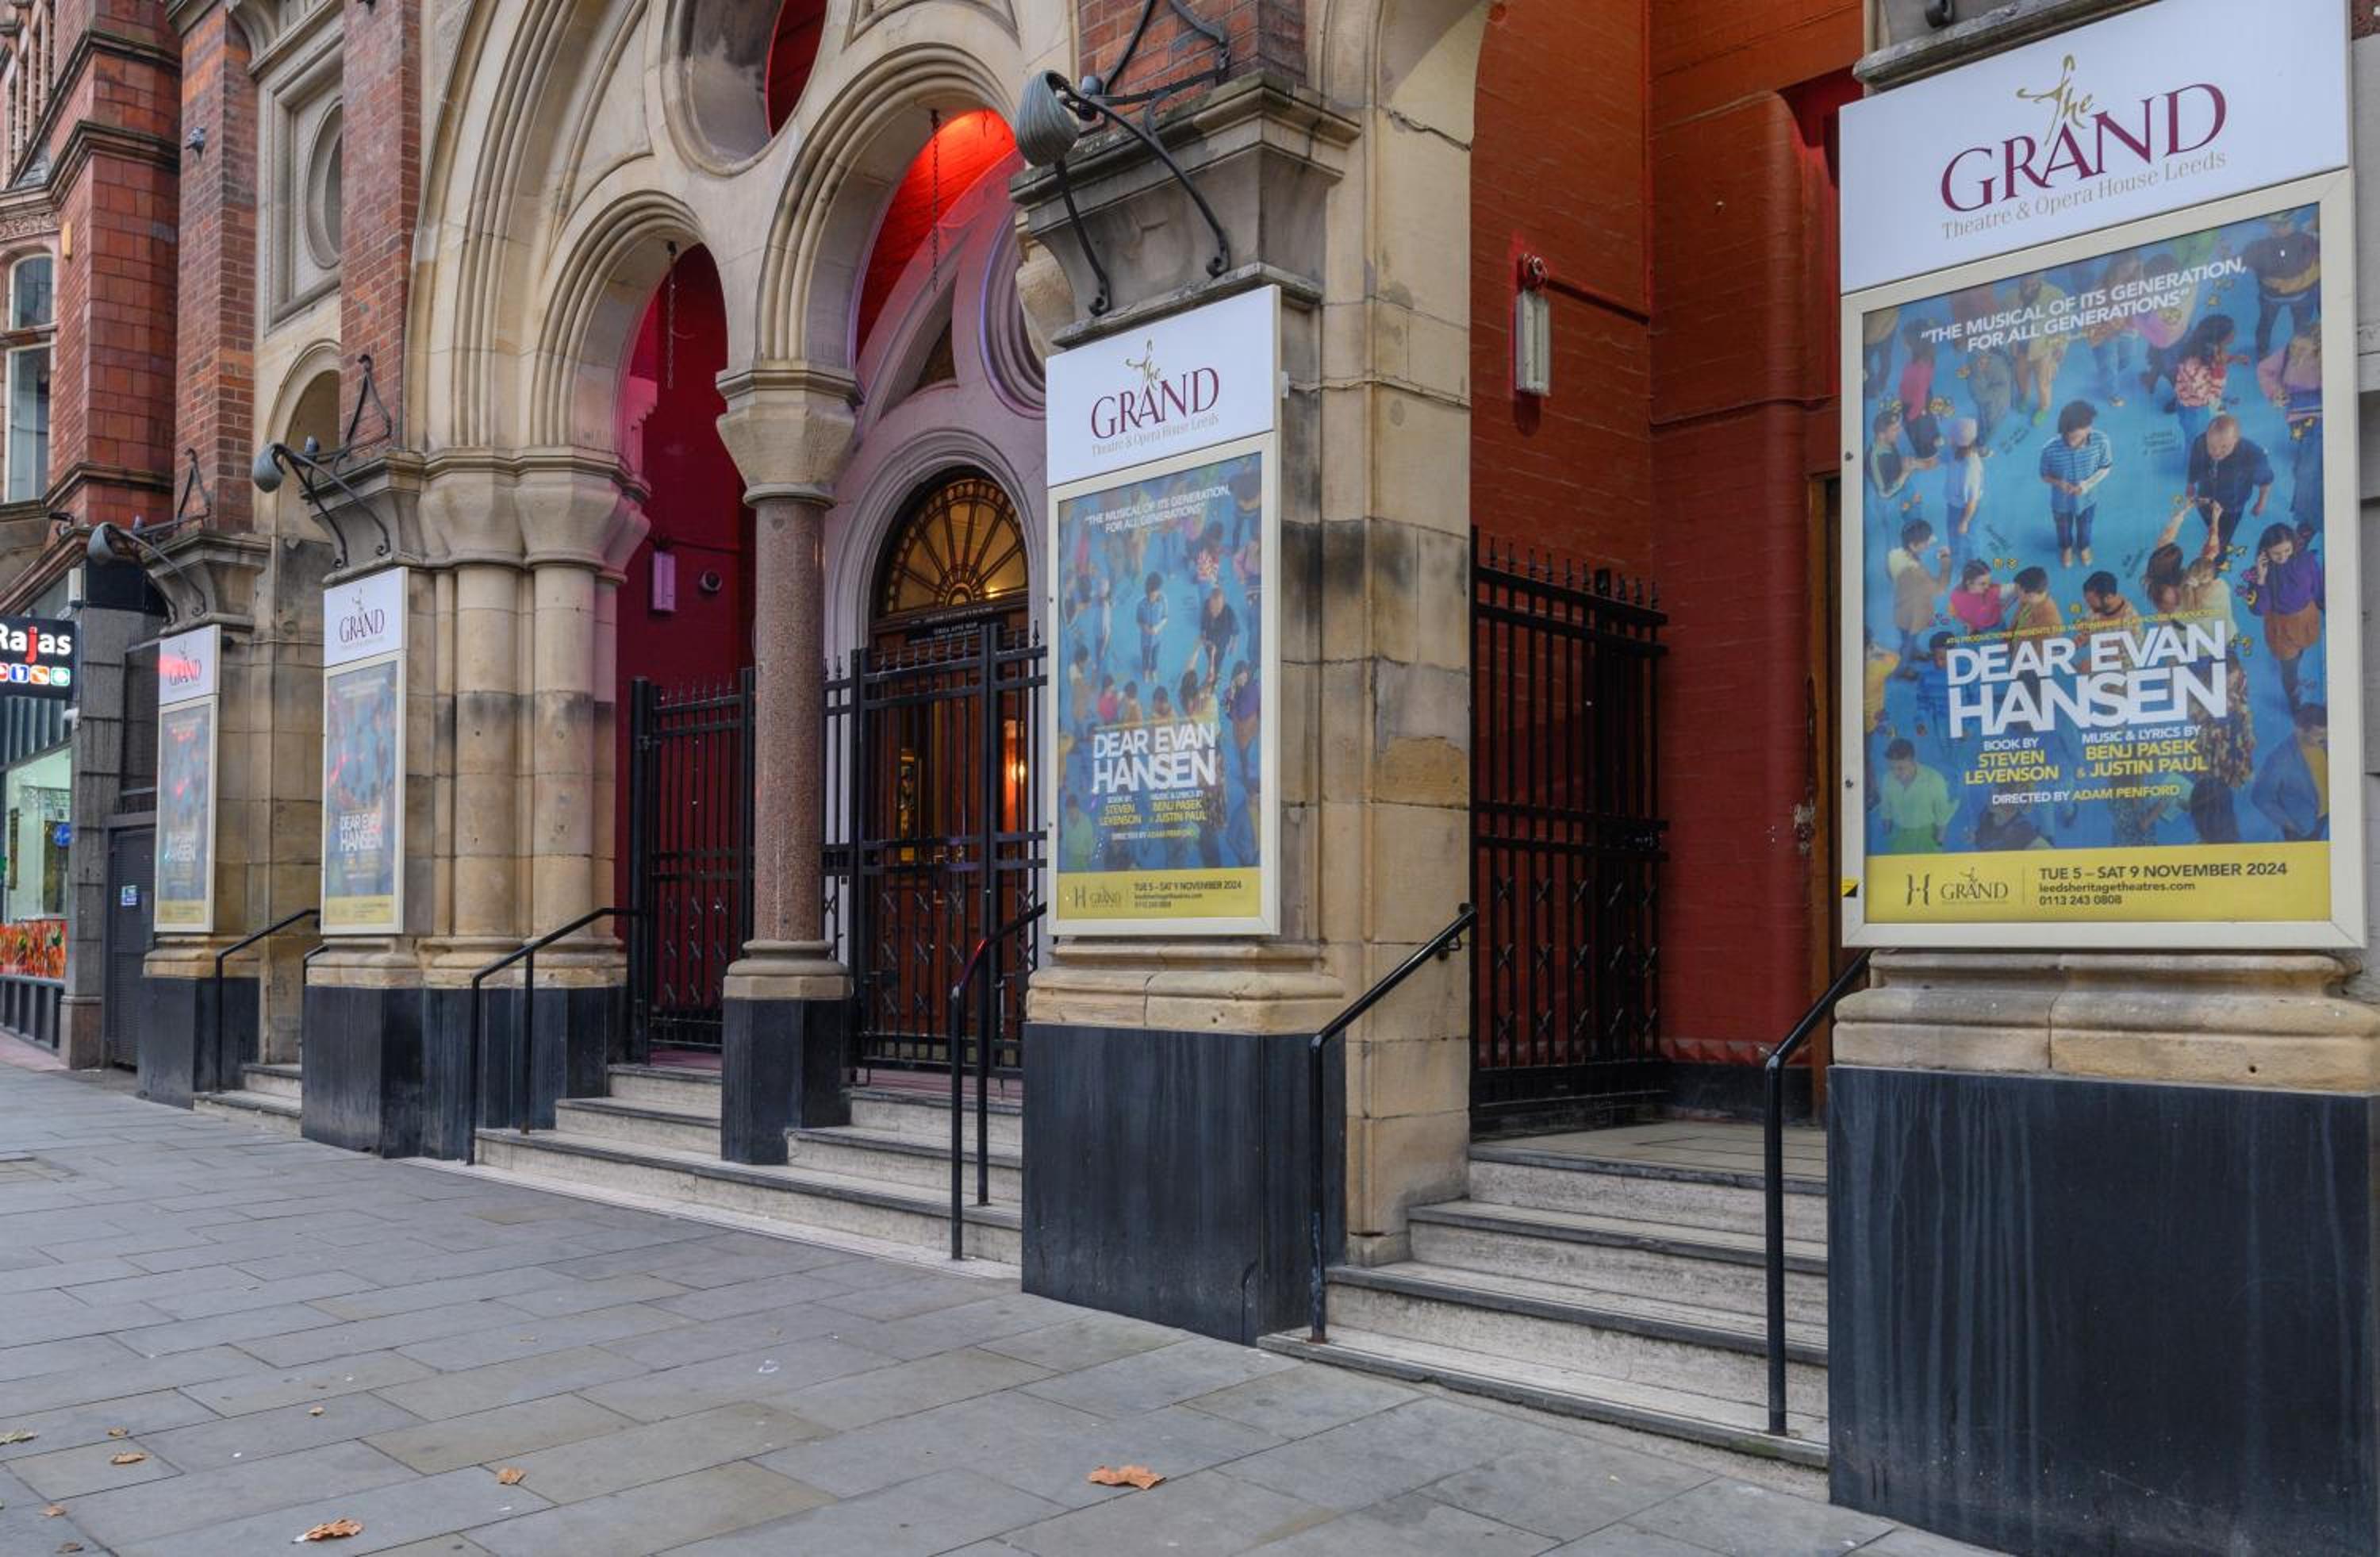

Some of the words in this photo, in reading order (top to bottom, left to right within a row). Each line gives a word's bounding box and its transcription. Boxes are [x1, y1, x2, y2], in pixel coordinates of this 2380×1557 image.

[2016, 55, 2094, 146] The
[1940, 83, 2227, 212] GRAND
[1941, 208, 2013, 239] Theatre
[2016, 204, 2030, 221] &
[2035, 188, 2094, 217] Opera
[2098, 168, 2159, 199] House
[2164, 151, 2227, 182] Leeds
[1966, 304, 2045, 335] MUSICAL
[2048, 296, 2077, 314] OF
[2080, 289, 2106, 309] ITS
[2110, 257, 2247, 302] GENERATION,
[1967, 333, 2005, 352] FOR
[2006, 324, 2041, 344] ALL
[1091, 367, 1219, 439] GRAND
[340, 609, 384, 643] GRAND
[1947, 638, 2076, 686] DEAR
[2090, 621, 2225, 672] EVAN
[1948, 661, 2228, 739] HANSEN
[1093, 729, 1149, 759] DEAR
[1154, 722, 1216, 753] EVAN
[1984, 739, 2021, 752] BOOK
[2023, 737, 2039, 748] BY
[2082, 732, 2123, 744] MUSIC
[2125, 729, 2136, 741] &
[2138, 727, 2182, 740] LYRICS
[2183, 725, 2202, 737] BY
[1979, 750, 2044, 768] STEVEN
[2086, 744, 2132, 762] BENJ
[2137, 739, 2198, 758] PASEK
[1092, 749, 1216, 794] HANSEN
[1965, 765, 2059, 786] LEVENSON
[2077, 767, 2086, 778] &
[2090, 759, 2153, 778] JUSTIN
[2158, 754, 2209, 773] PAUL
[1992, 792, 2051, 805] DIRECTED
[2053, 791, 2070, 802] BY
[2072, 787, 2113, 802] ADAM
[2116, 784, 2180, 799] PENFORD
[1185, 810, 1207, 821] PAUL
[2039, 867, 2068, 880] TUE
[2073, 867, 2082, 879] 5
[2097, 866, 2126, 879] SAT
[2130, 866, 2140, 878] 9
[2144, 863, 2241, 878] NOVEMBER
[2247, 862, 2287, 876] 2024
[1180, 881, 1222, 890] NOVEMBER
[1224, 880, 1242, 890] 2024
[1940, 882, 2009, 901] GRAND
[2039, 882, 2196, 894] leedsheritagetheatres.com
[2039, 894, 2067, 905] 0113
[2070, 894, 2090, 905] 243
